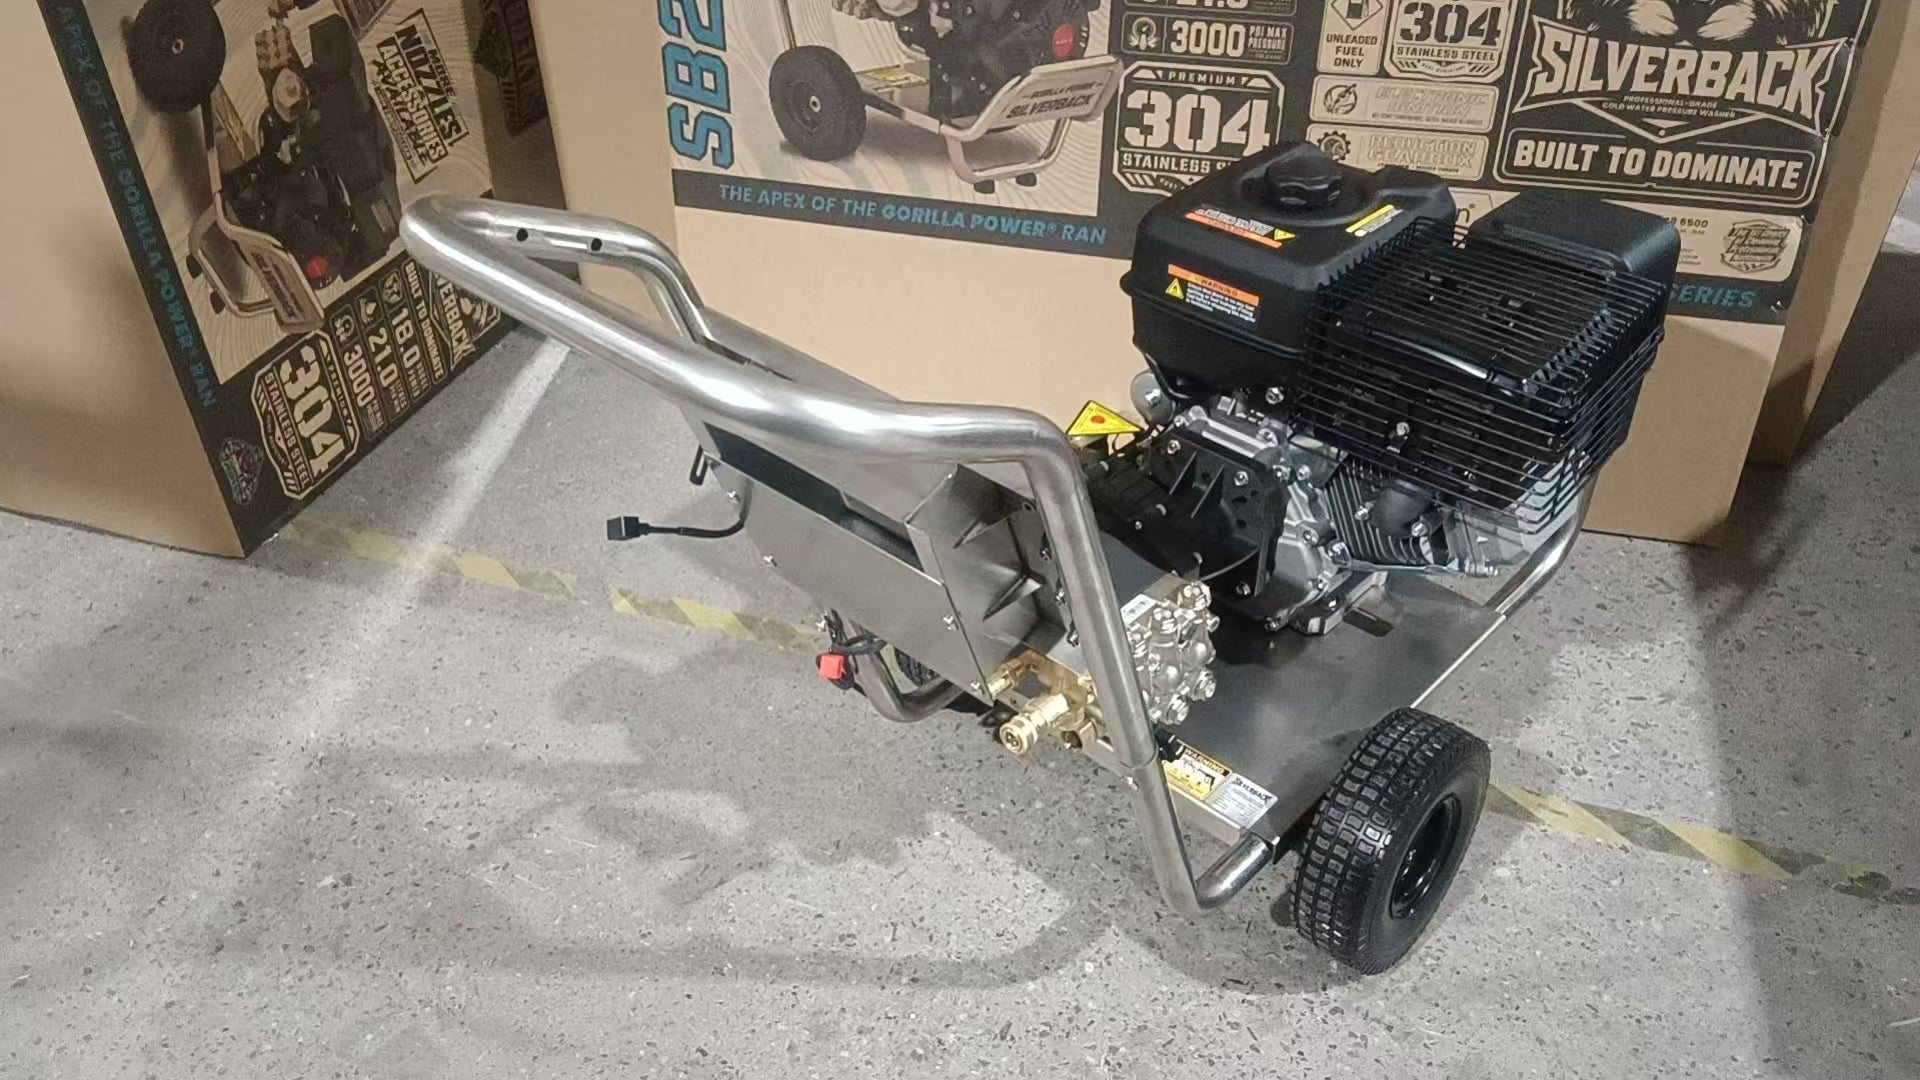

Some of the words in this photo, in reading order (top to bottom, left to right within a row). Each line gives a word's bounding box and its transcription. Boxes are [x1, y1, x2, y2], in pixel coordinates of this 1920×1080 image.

[1170, 19, 1246, 57] 3000
[1249, 25, 1265, 38] PSI
[1266, 26, 1288, 39] MAX
[1326, 34, 1378, 46] UNLEADED
[1400, 2, 1502, 46] 304
[428, 48, 456, 96] MORE
[1333, 58, 1364, 69] ONLY
[1335, 46, 1365, 57] FUEL
[1396, 46, 1458, 60] STAINLESS
[1461, 51, 1496, 62] STEEL
[1532, 25, 1834, 120] SILVERBACK
[395, 24, 462, 140] NOZZLES
[1168, 71, 1236, 86] PREMIUM
[381, 46, 446, 162] ACCESSORIES
[1124, 90, 1270, 156] 304
[1602, 102, 1625, 110] COLD
[1122, 152, 1212, 174] STAINLESS
[1513, 138, 1599, 172] BUILT
[1607, 146, 1647, 177] TO
[1651, 149, 1803, 189] DOMINATE
[719, 184, 752, 201] THE
[757, 189, 805, 209] APEX
[811, 196, 837, 212] OF
[843, 199, 877, 217] THE
[881, 203, 966, 229] GORILLA
[1061, 223, 1106, 244] RAN
[102, 115, 127, 163] THE
[118, 167, 163, 268] GORILLA
[190, 362, 216, 407] RAN
[405, 262, 423, 299] BUILT
[416, 300, 428, 320] TO
[369, 327, 398, 388] 21.0
[392, 308, 421, 369] 18.0
[420, 319, 444, 380] DOMINATE
[344, 344, 375, 407] 3000
[265, 372, 297, 447] STAINLESS
[291, 449, 310, 490] STEEL
[279, 345, 346, 478] 304
